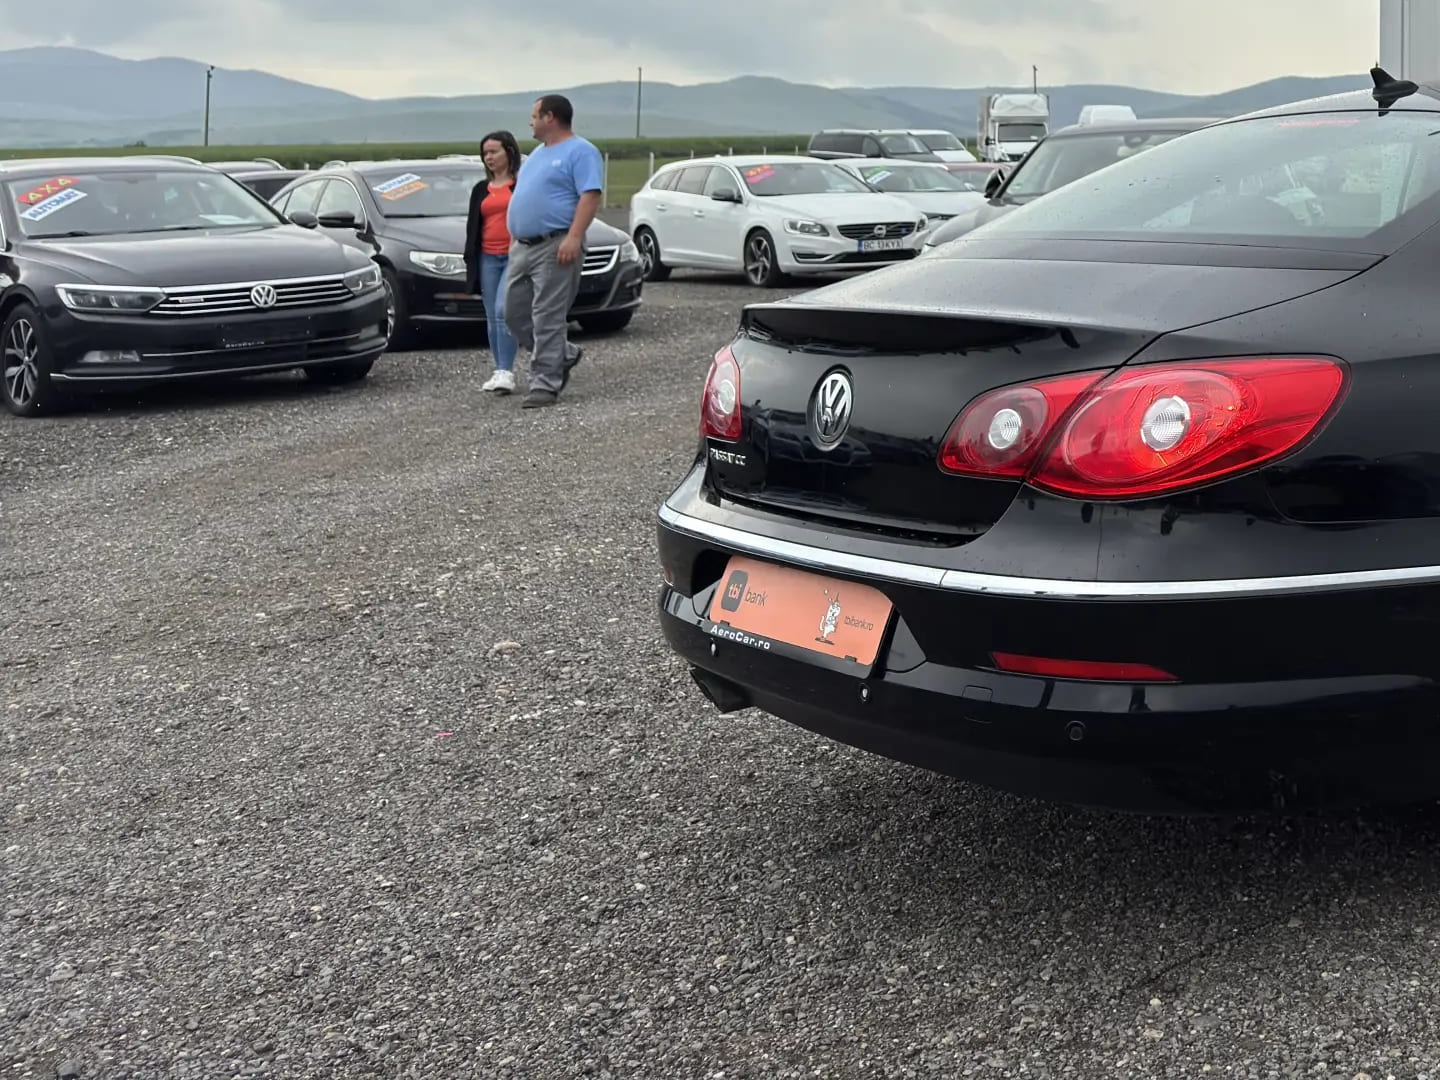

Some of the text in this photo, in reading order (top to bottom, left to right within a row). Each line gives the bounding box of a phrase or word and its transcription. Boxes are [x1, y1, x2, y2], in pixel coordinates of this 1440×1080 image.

[28, 190, 79, 218] AUTOMAT
[728, 583, 743, 600] tbi
[745, 586, 768, 606] bank
[710, 624, 770, 650] AeroCar.ro
